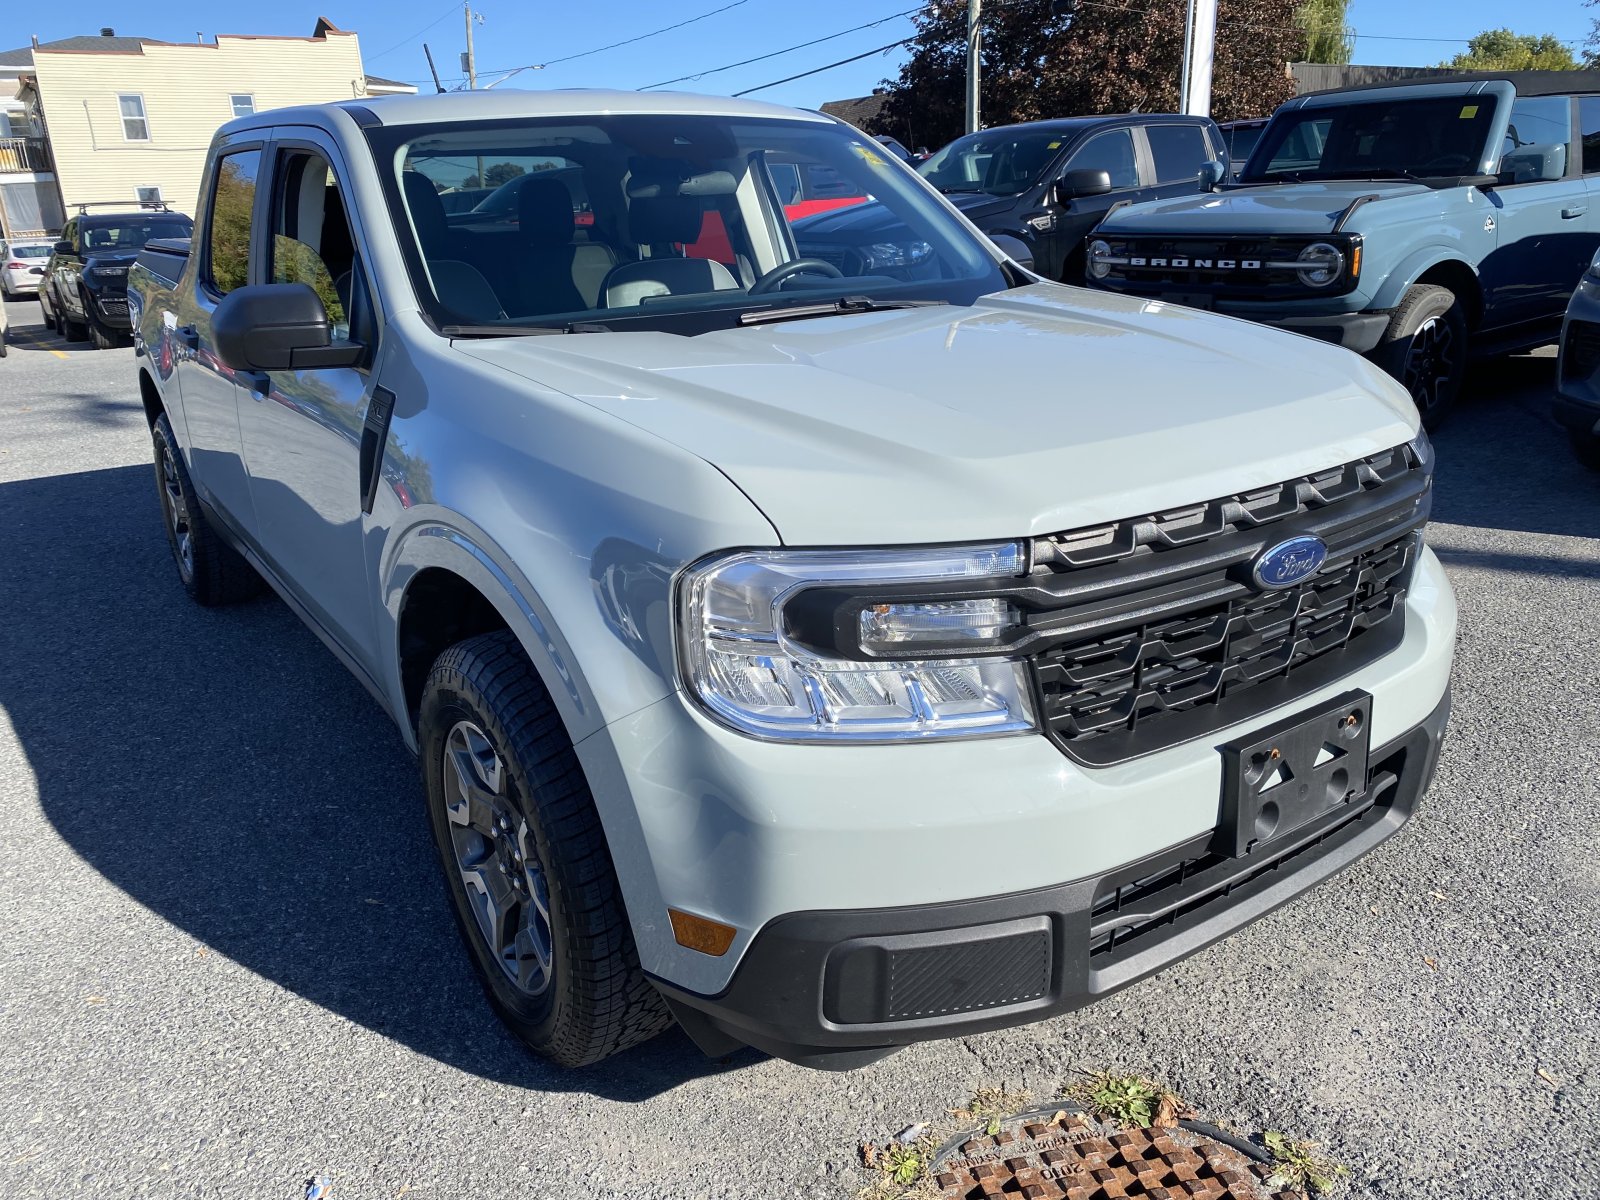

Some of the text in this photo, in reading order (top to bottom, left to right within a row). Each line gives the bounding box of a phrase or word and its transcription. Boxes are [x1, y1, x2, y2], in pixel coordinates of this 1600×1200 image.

[1130, 257, 1261, 269] BRONCO
[1276, 548, 1316, 580] Ford
[1040, 1162, 1084, 1180] 2010
